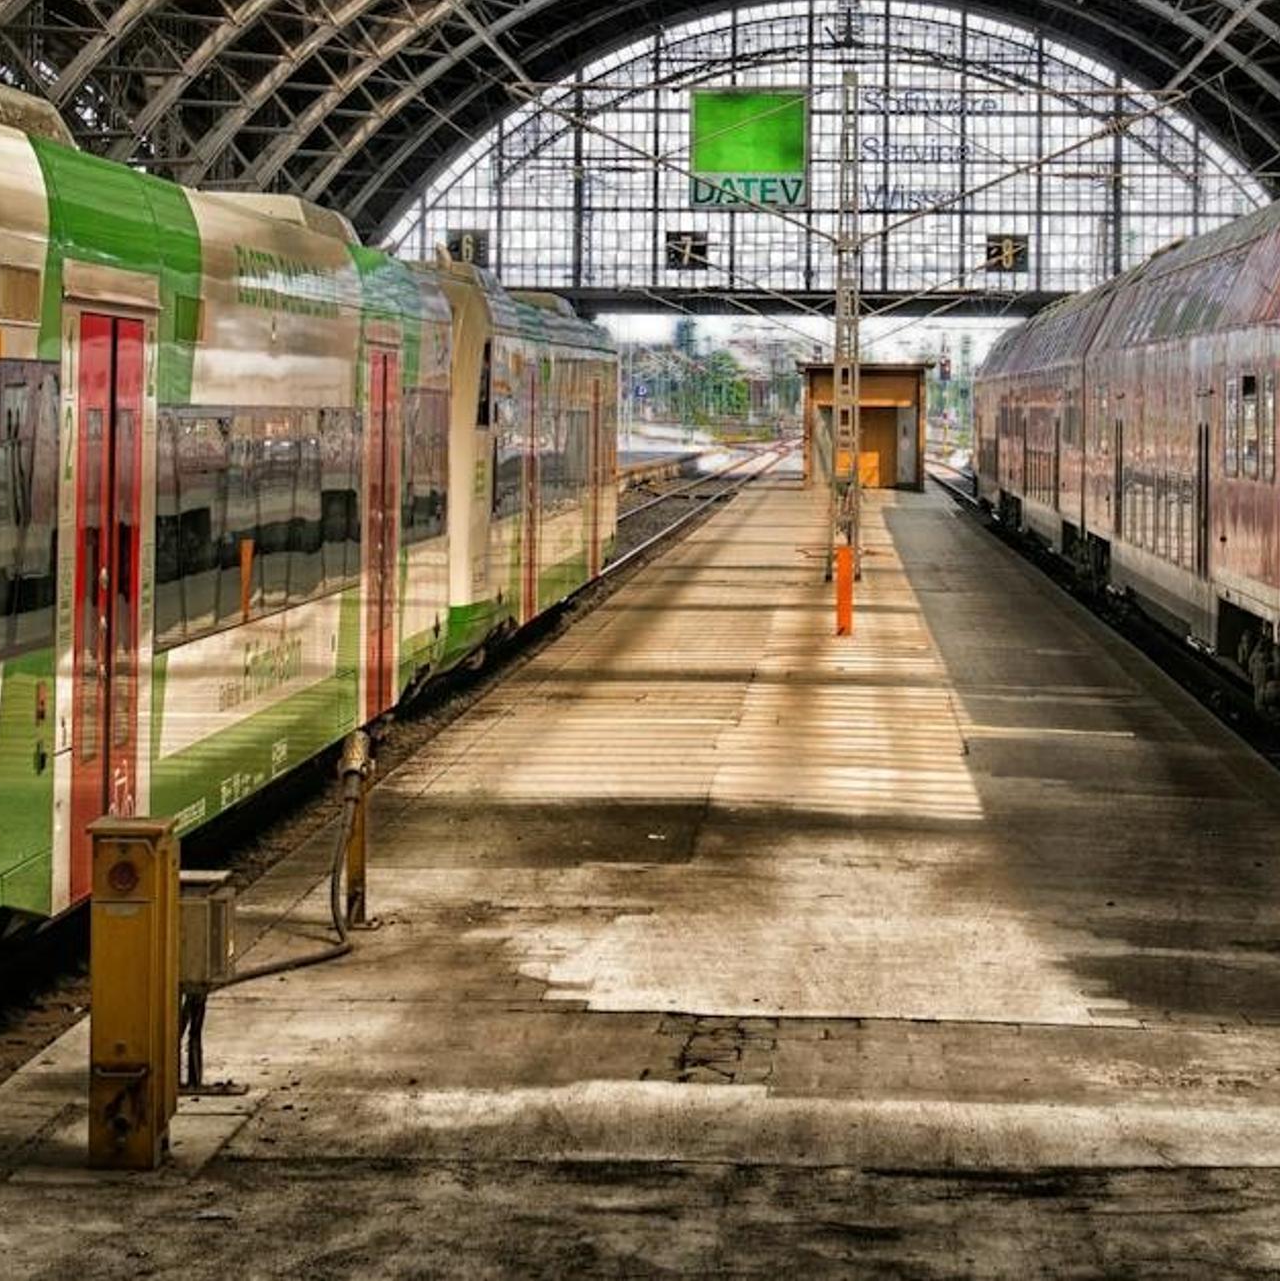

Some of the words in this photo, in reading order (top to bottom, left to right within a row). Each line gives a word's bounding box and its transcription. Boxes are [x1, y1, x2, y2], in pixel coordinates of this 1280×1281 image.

[863, 90, 997, 115] Software
[861, 136, 970, 162] Service
[694, 178, 804, 204] DATEV
[461, 234, 473, 262] 6
[680, 235, 692, 265] 7
[1001, 238, 1013, 268] 8
